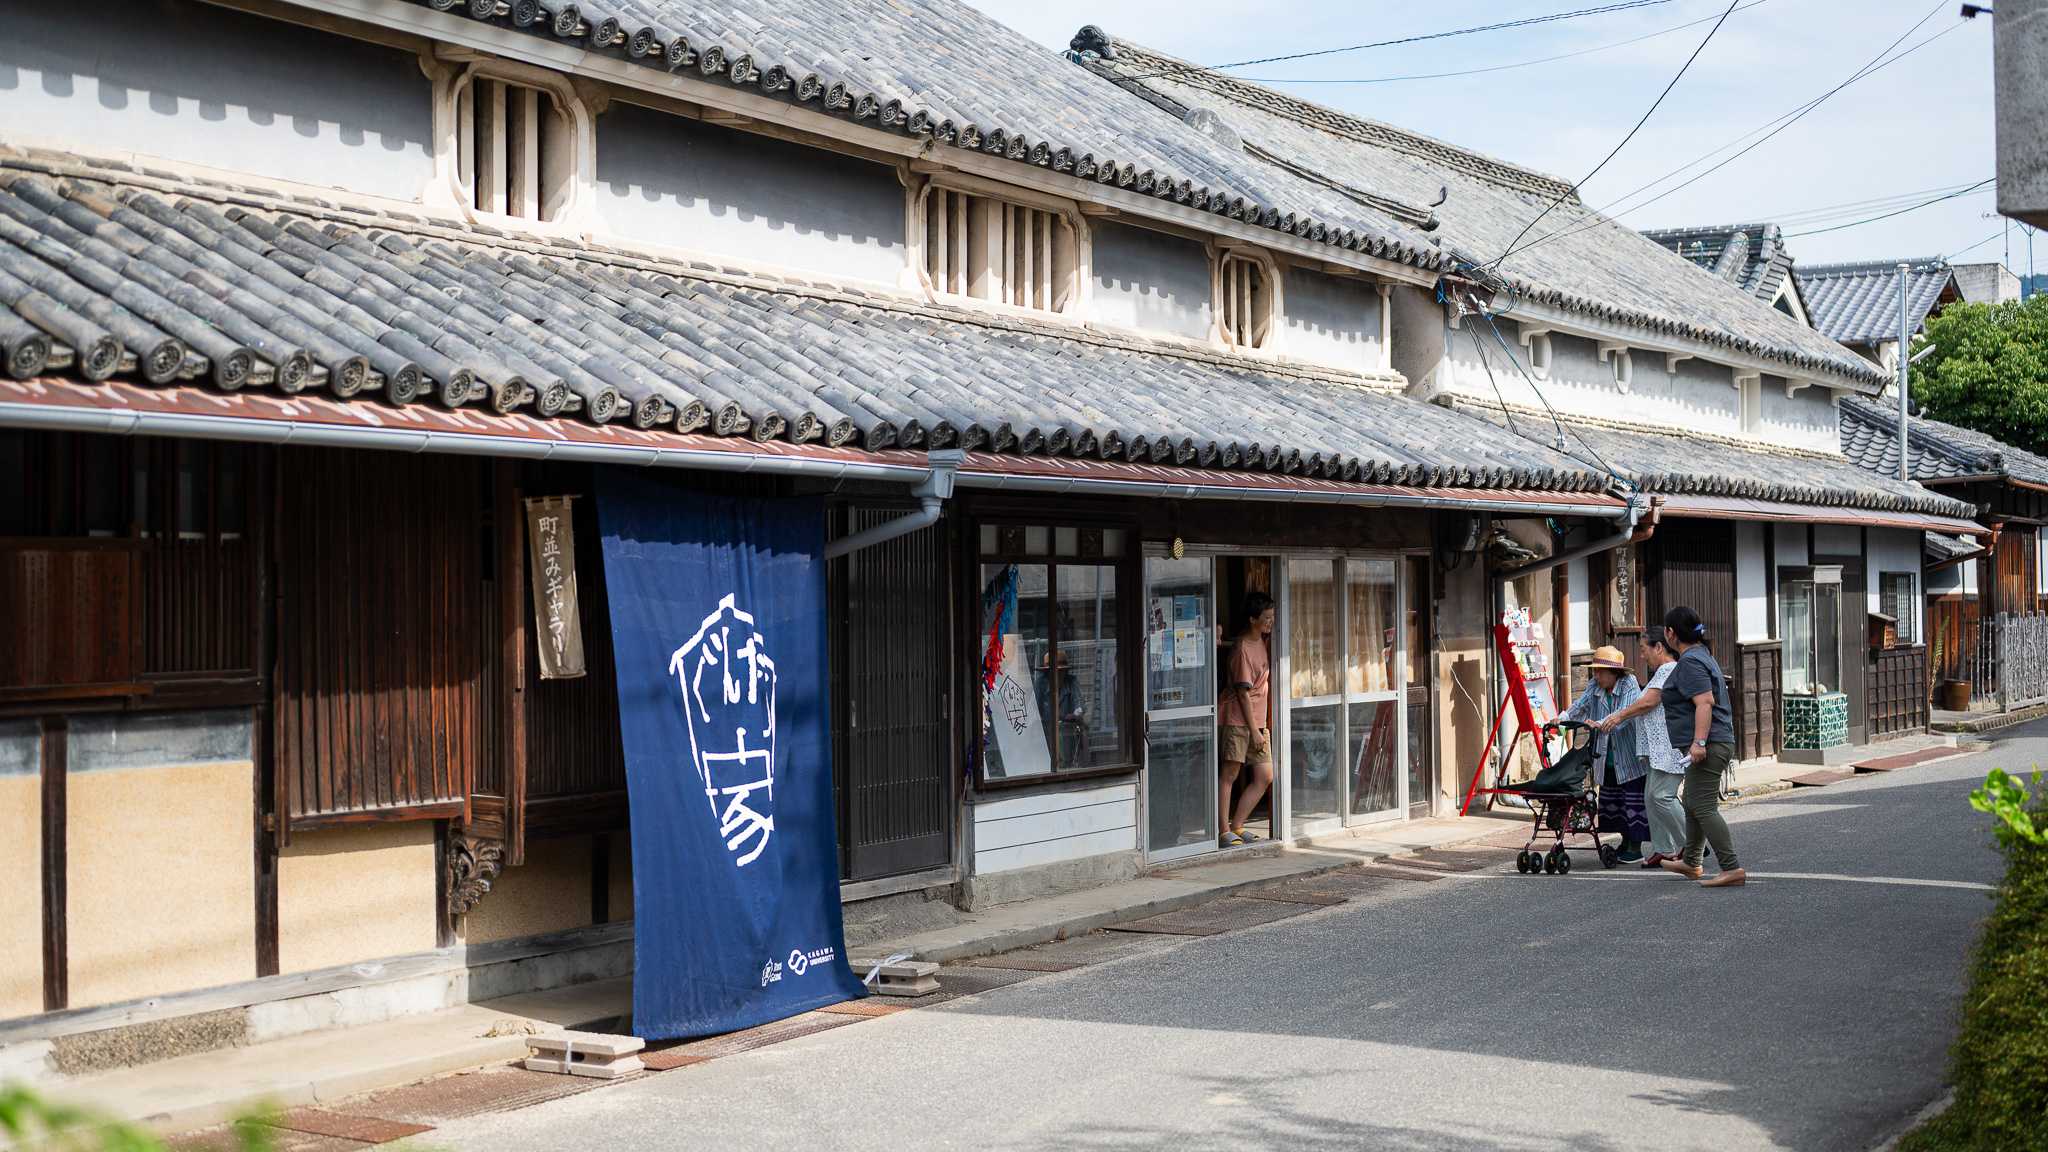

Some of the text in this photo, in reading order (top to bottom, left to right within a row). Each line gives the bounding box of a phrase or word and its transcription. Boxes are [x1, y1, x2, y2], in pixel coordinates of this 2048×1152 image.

[538, 516, 565, 668] 町並みギャラリー
[1616, 547, 1629, 623] 町並みギャラリー
[807, 946, 834, 959] KAGAWA
[809, 953, 835, 967] UNIVERSITY
